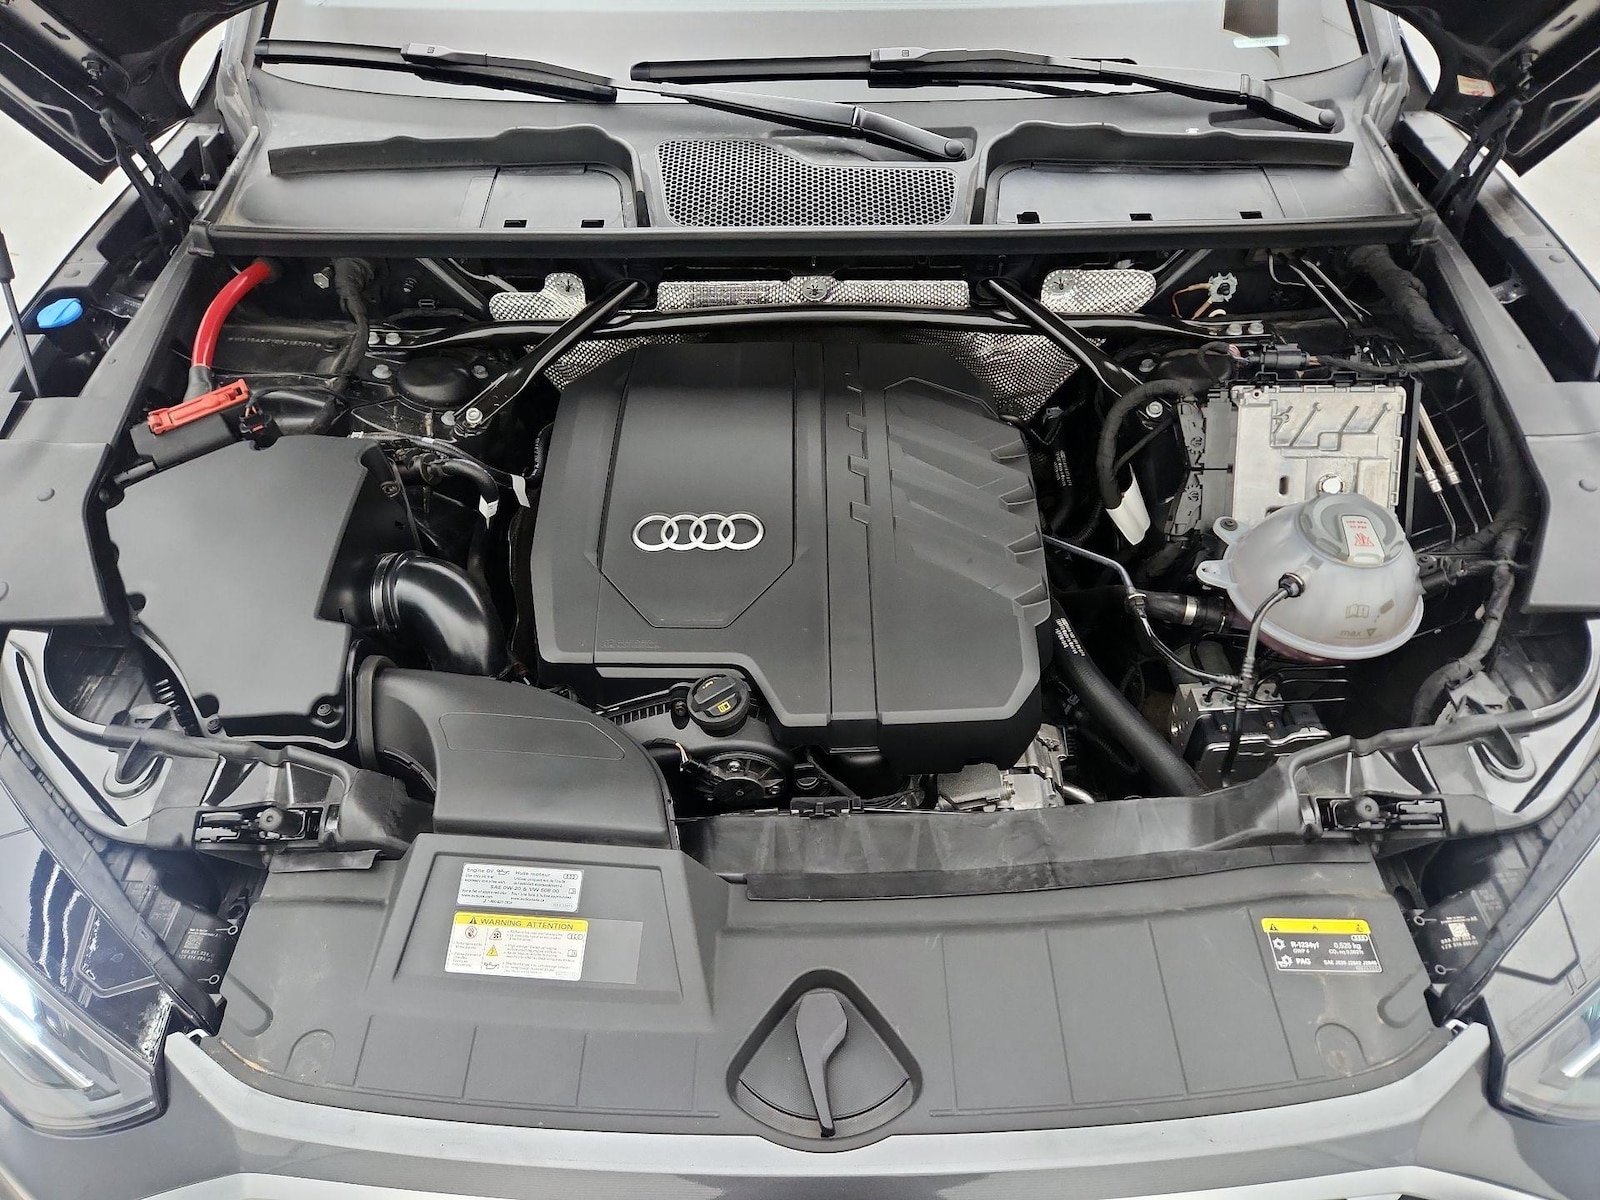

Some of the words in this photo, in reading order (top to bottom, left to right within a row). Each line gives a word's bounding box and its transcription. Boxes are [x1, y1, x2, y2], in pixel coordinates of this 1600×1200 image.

[481, 918, 521, 927] WARNING
[526, 921, 574, 930] ATTENTION
[1295, 957, 1311, 965] PAG
